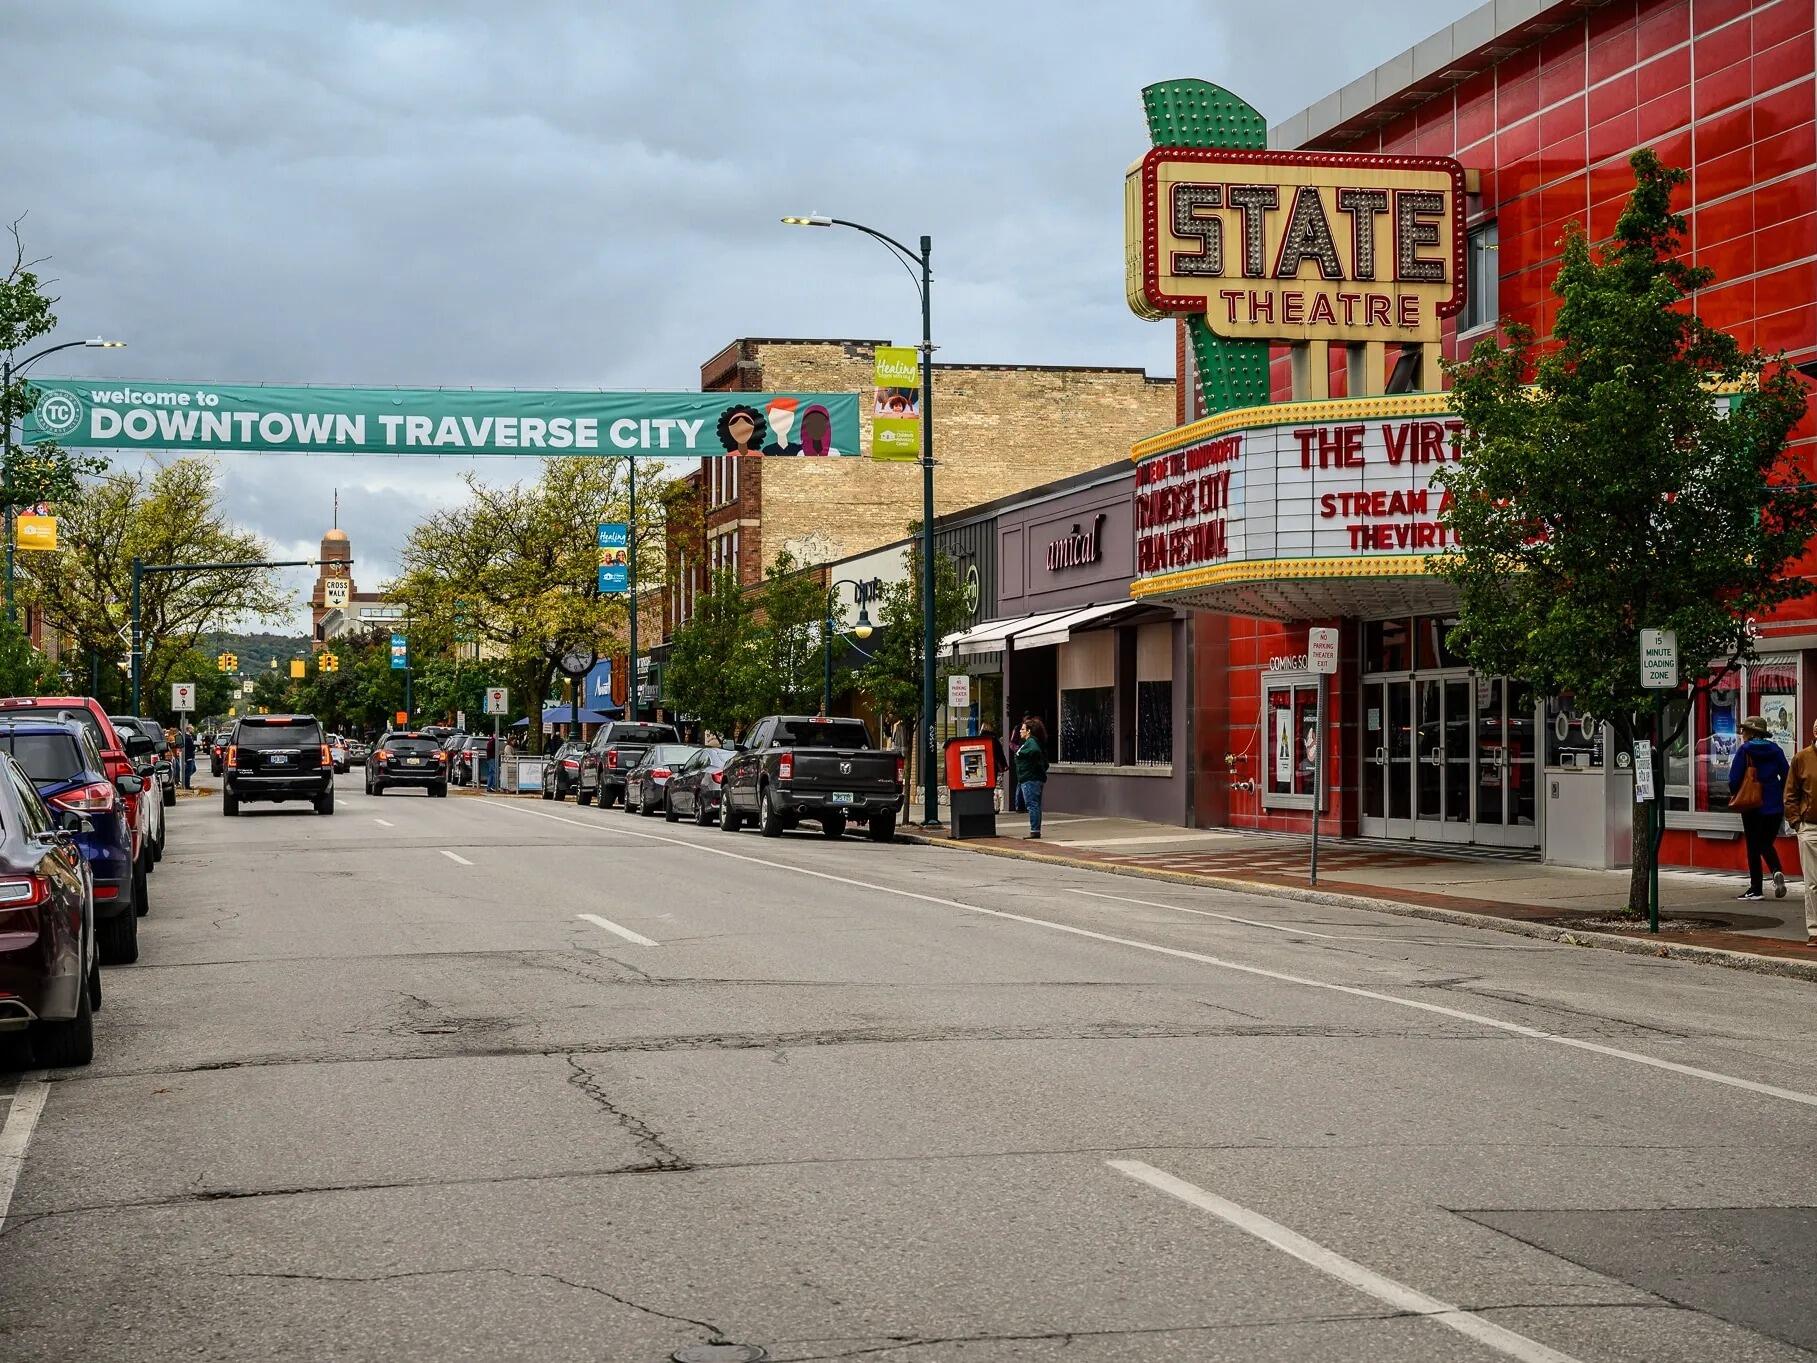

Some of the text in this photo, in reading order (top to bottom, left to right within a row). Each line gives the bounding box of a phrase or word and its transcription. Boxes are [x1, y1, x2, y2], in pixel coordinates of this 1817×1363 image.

[1169, 182, 1446, 282] STATE
[1220, 290, 1420, 326] THEATRE
[876, 359, 917, 383] Healing
[91, 387, 219, 406] welcome to
[47, 405, 69, 421] TC
[91, 408, 704, 450] DOWNTOWN TRAVERSE CITY
[1293, 420, 1468, 469] THE VIRT
[1135, 469, 1231, 531] TRAVERSE CITY
[1320, 489, 1428, 518] STREAM
[600, 531, 626, 544] Healing
[1046, 513, 1106, 571] amical
[1138, 518, 1228, 574] FILM FESTIVAL
[1347, 521, 1462, 550] THEVIRT
[326, 581, 348, 589] CROSS
[1646, 649, 1671, 657] MINUTE
[1655, 637, 1663, 645] 15
[1270, 654, 1309, 671] COMING SO
[1644, 660, 1675, 668] LOADING
[1650, 671, 1669, 679] ZONE
